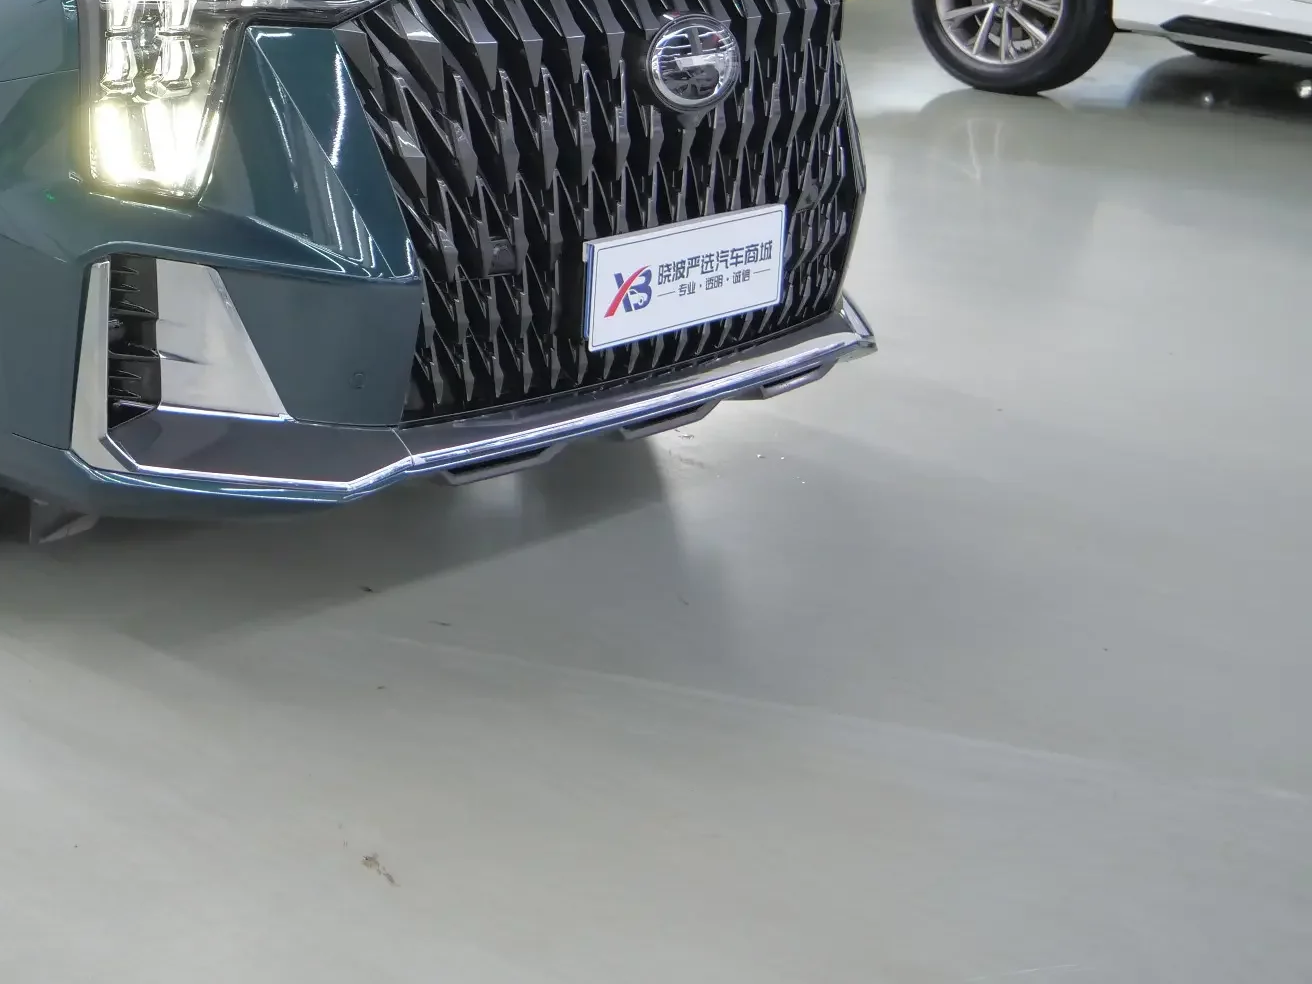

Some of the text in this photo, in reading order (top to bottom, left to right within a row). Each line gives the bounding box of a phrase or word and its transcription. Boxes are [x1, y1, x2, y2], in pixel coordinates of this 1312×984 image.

[657, 240, 773, 285] 晓波严选汽车商城
